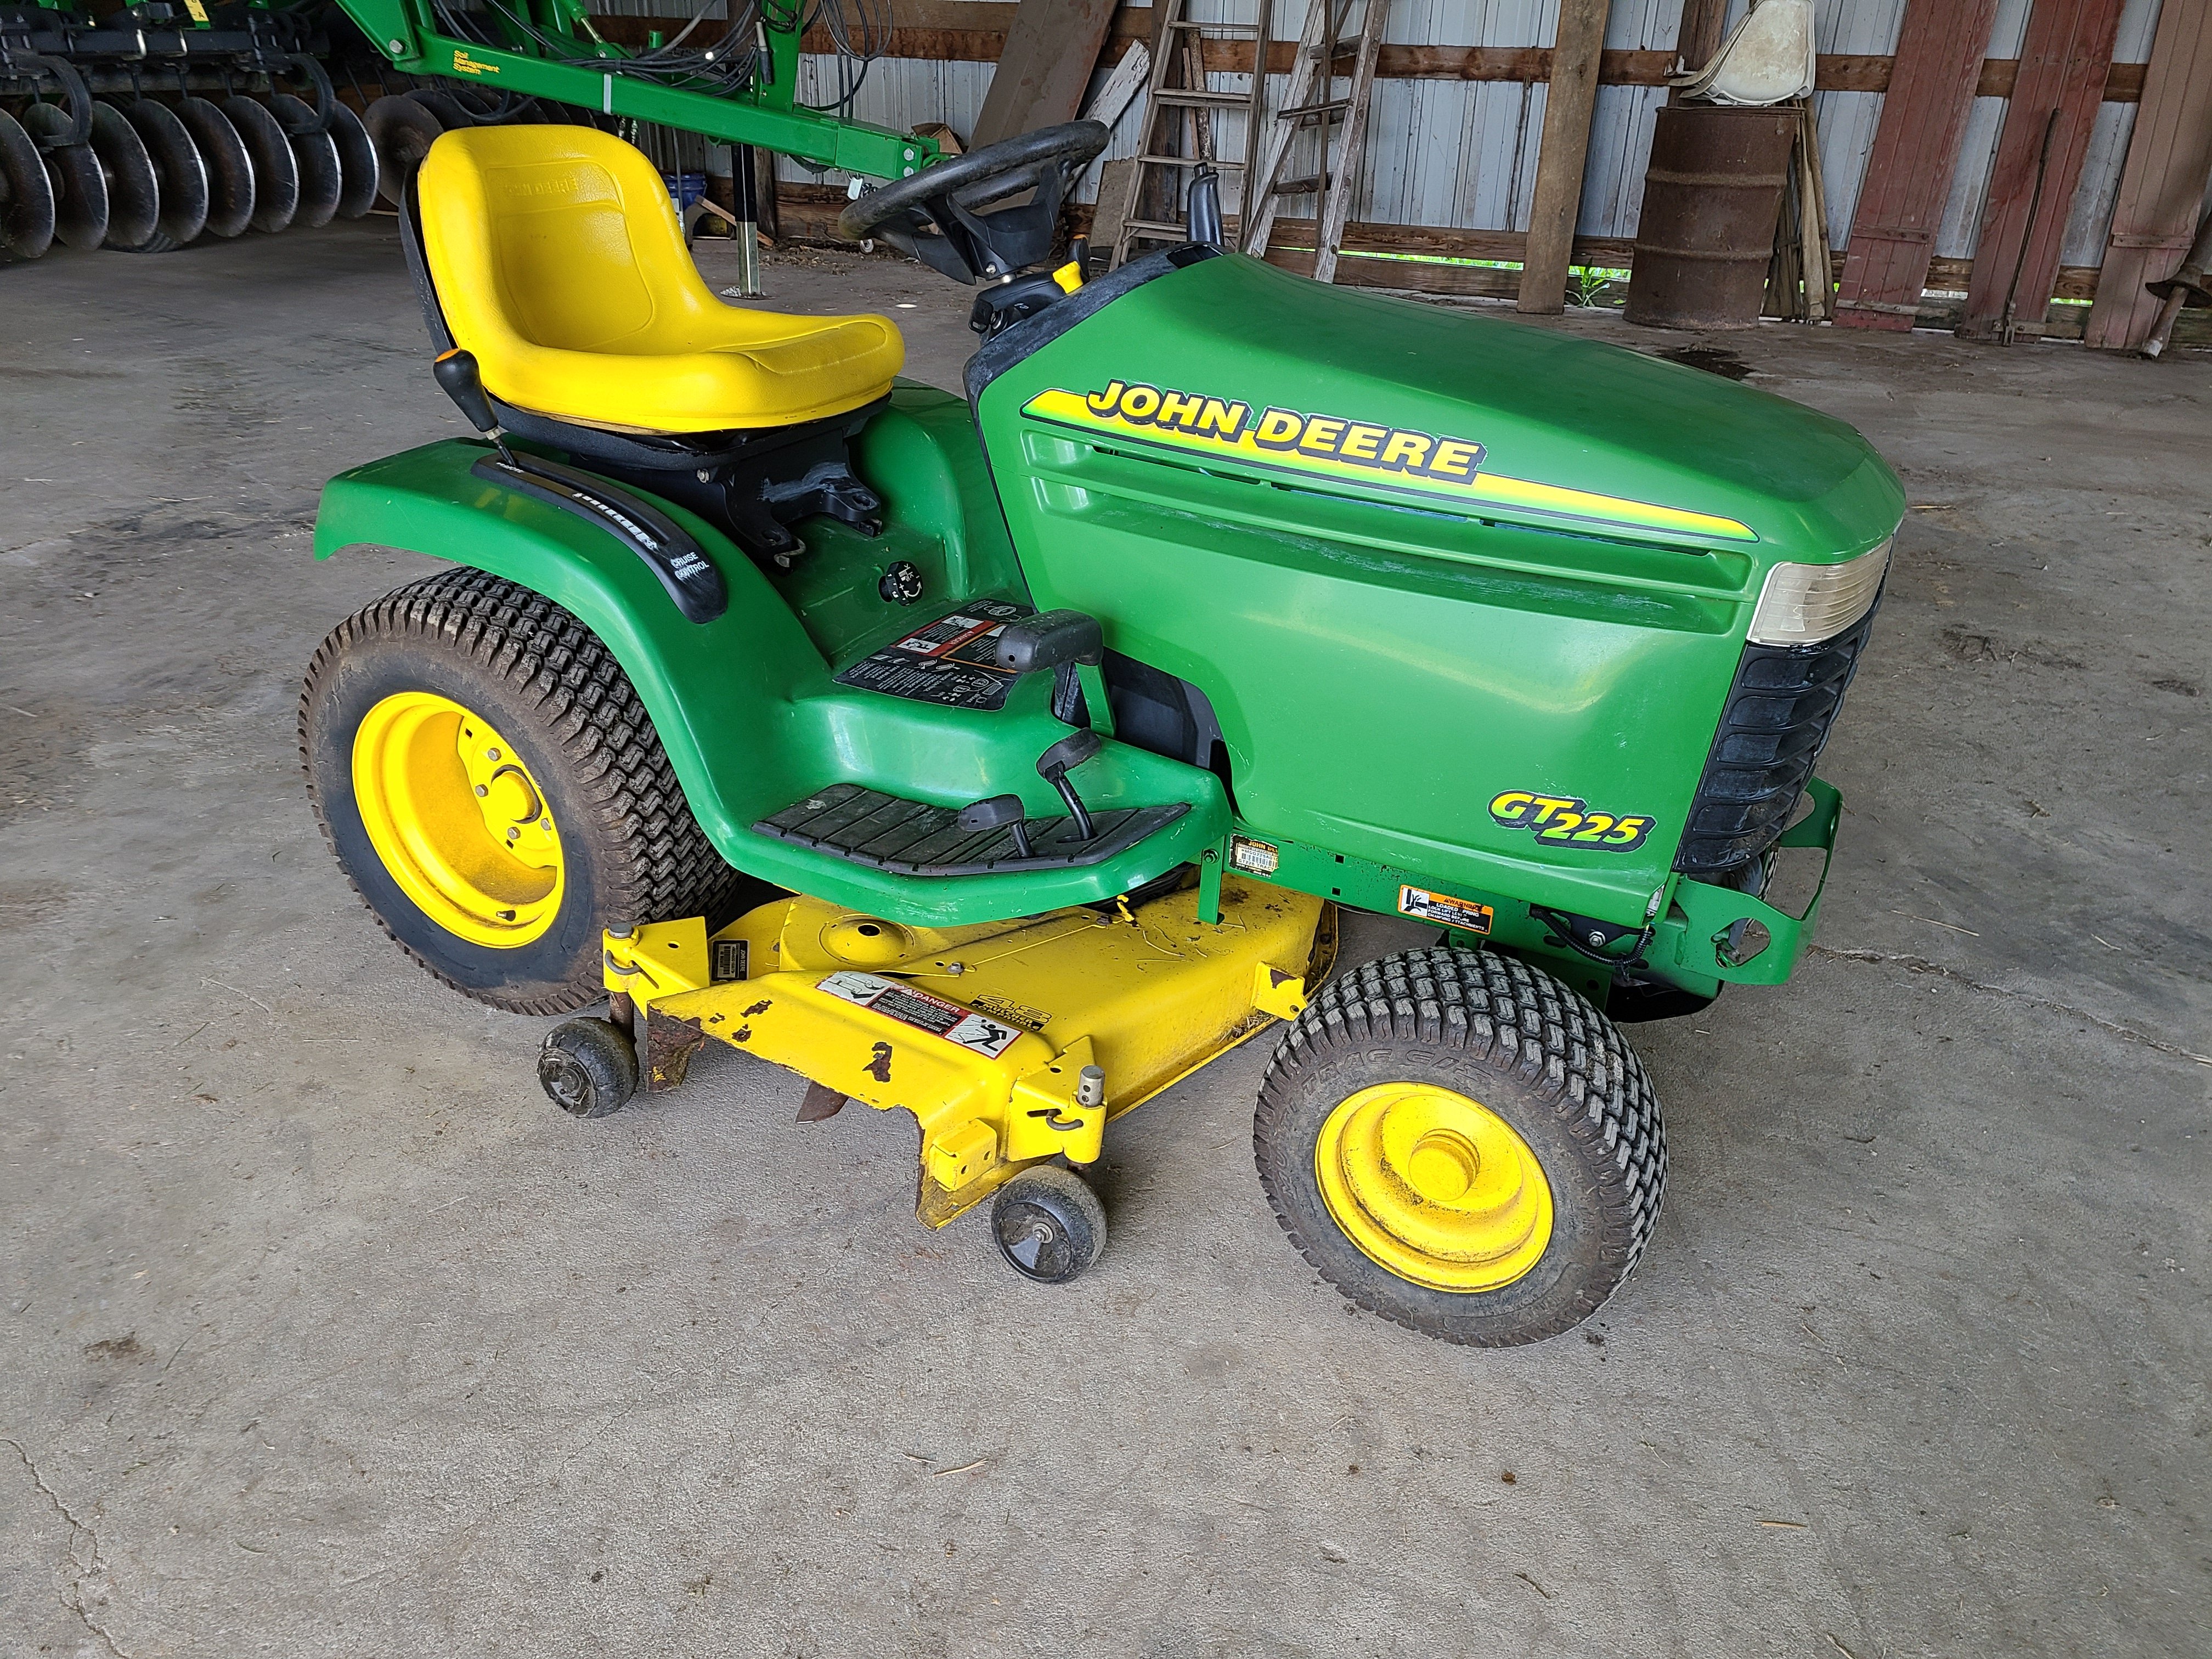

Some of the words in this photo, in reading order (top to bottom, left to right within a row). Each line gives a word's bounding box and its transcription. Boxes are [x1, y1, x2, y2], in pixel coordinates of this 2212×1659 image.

[454, 50, 469, 59] Soil
[453, 63, 482, 75] System
[454, 57, 500, 74] Management
[1087, 380, 1252, 443] JOHN
[1256, 408, 1486, 484] DEERE
[670, 551, 698, 568] CRUISE
[675, 560, 709, 580] CONTROL
[949, 631, 969, 645] DANGER
[1248, 841, 1266, 849] JOHN
[1427, 909, 1451, 918] FORWARD
[1436, 902, 1459, 912] LOADED
[1459, 909, 1480, 917] PRING
[890, 998, 917, 1010] THROWN
[899, 994, 930, 1007] ROTATING
[914, 991, 960, 1013] DANGER
[977, 994, 1053, 1024] 48
[972, 1003, 1040, 1030] COMPATIBLE
[982, 1003, 1032, 1024] MULCHER
[1300, 1048, 1394, 1096] TRAC
